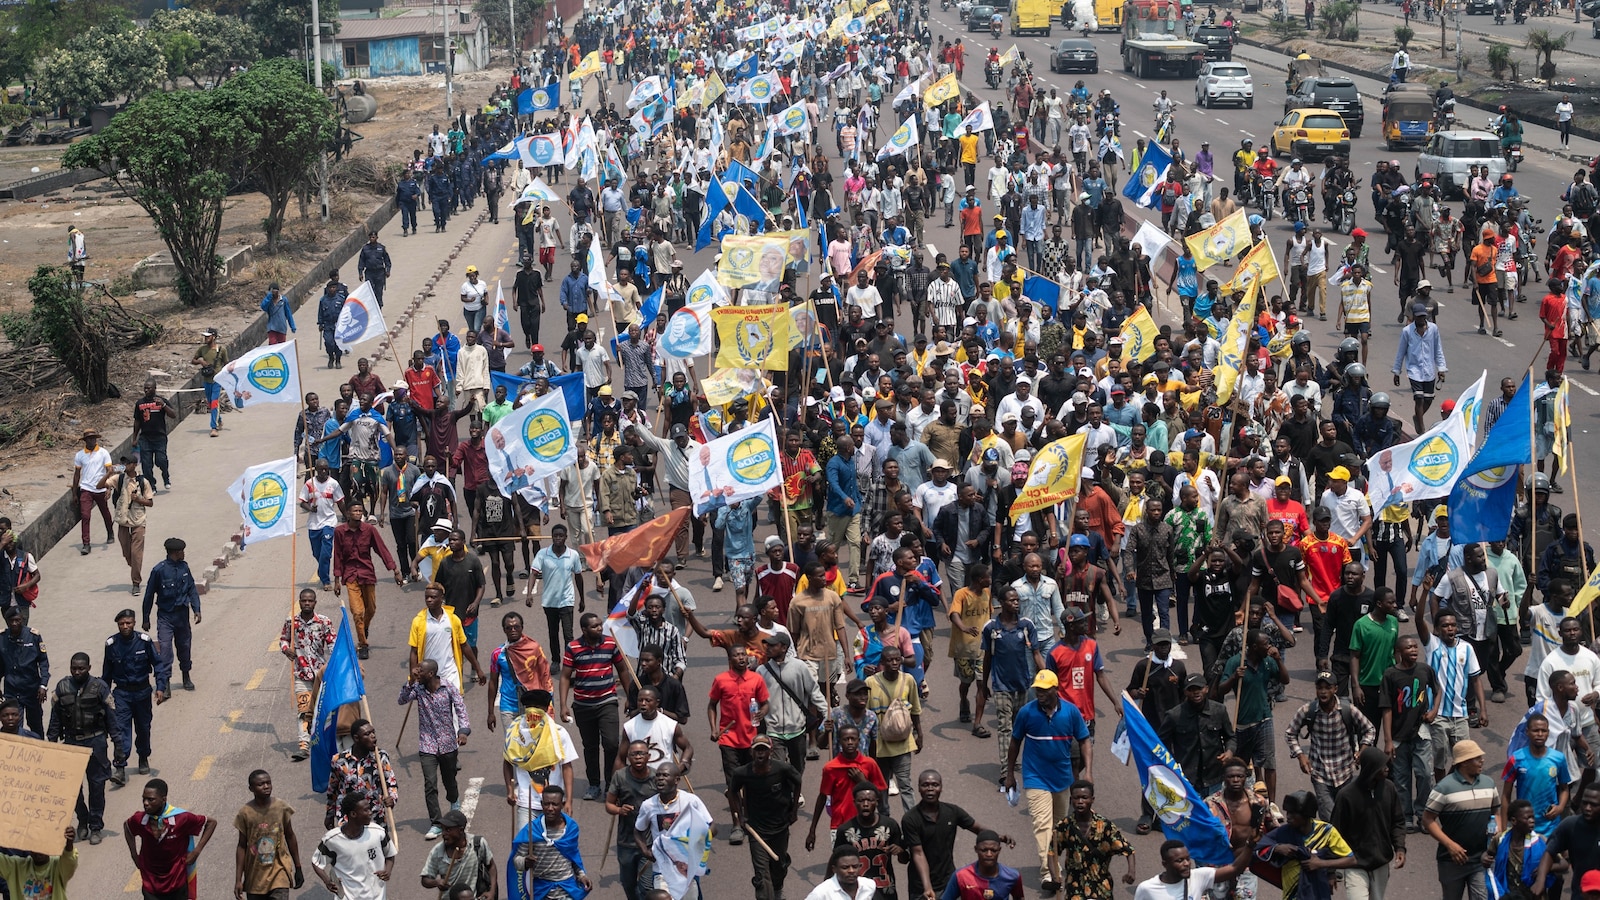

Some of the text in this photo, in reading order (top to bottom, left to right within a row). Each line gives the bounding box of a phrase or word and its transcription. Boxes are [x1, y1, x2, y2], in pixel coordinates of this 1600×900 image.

[1026, 487, 1049, 498] A.Ch
[34, 767, 67, 781] CHAQUE
[35, 783, 51, 794] UNE
